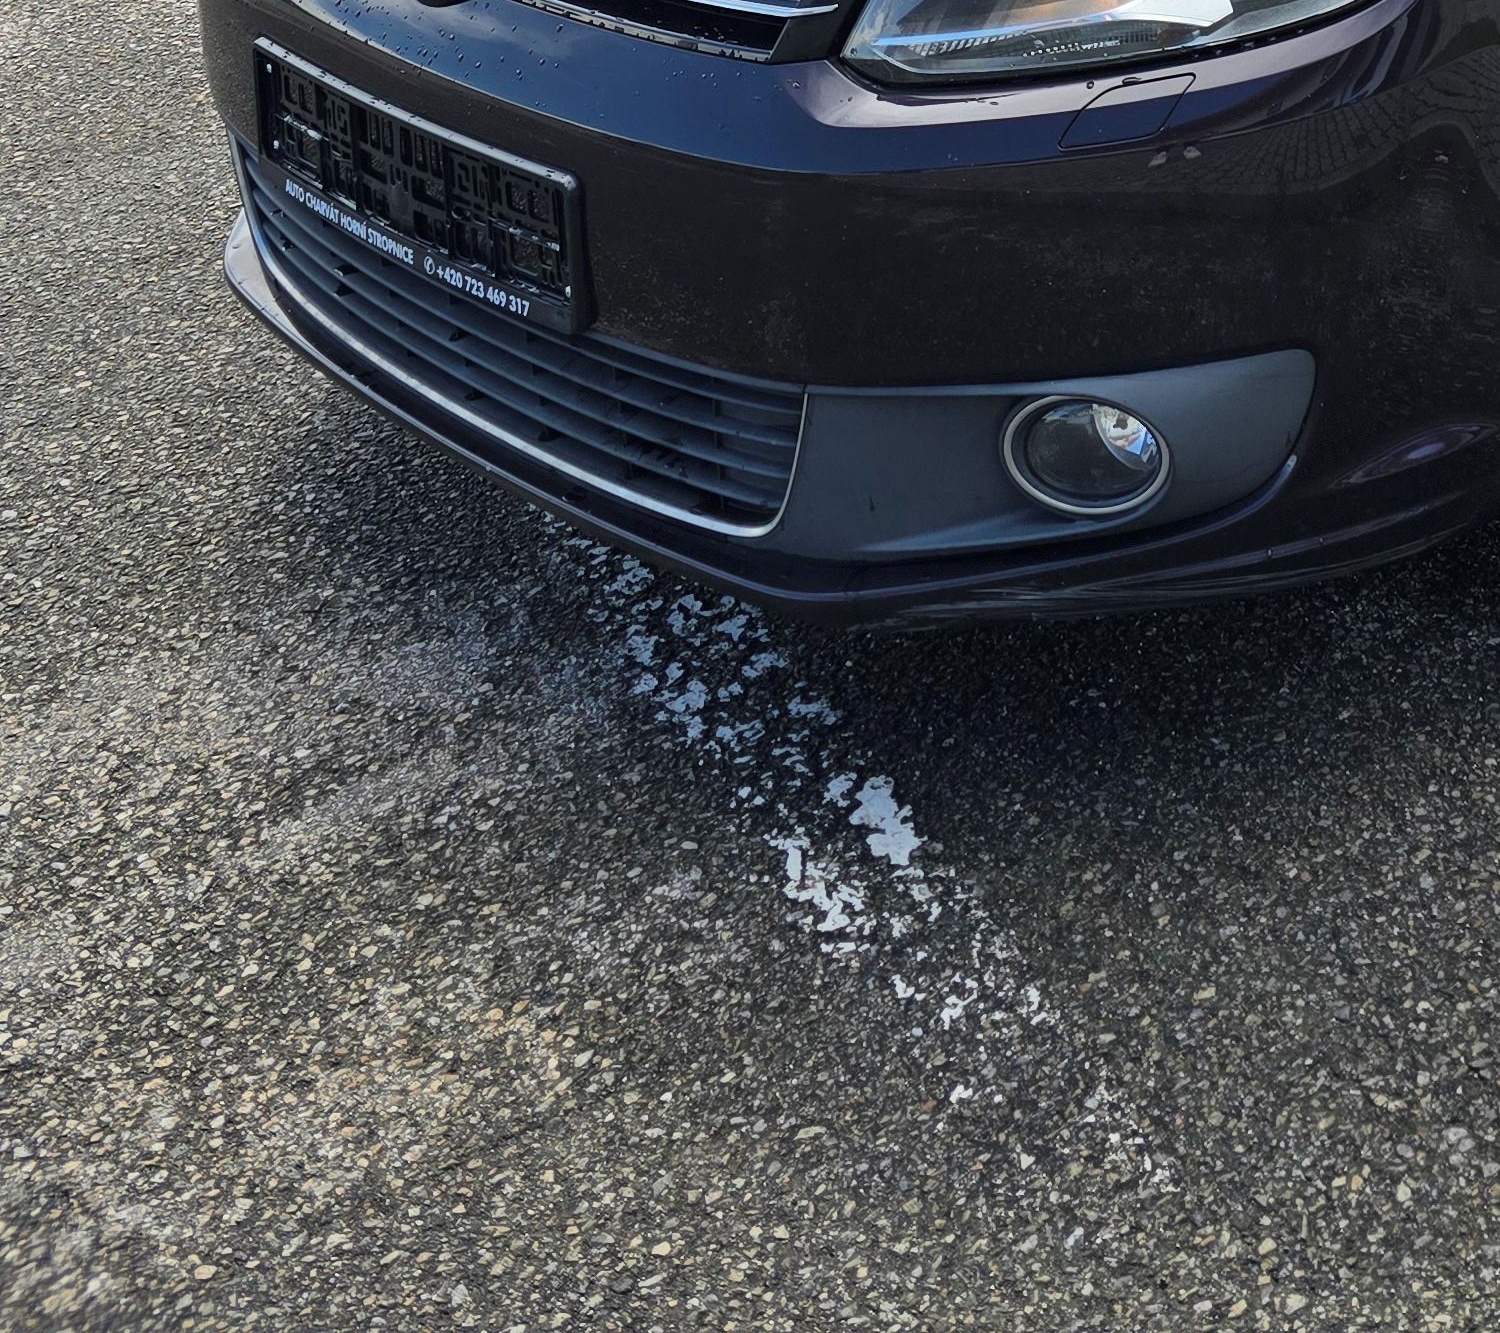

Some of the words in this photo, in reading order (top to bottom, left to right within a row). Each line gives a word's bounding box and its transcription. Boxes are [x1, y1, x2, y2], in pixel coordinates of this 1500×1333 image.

[285, 179, 305, 203] AUTO
[305, 192, 340, 224] CHARVÁT
[340, 212, 367, 240] HORNÍ
[367, 228, 414, 265] STROPNICE
[436, 265, 463, 289] +420
[464, 275, 484, 299] 723
[486, 286, 507, 308] 469
[508, 295, 530, 317] 317
